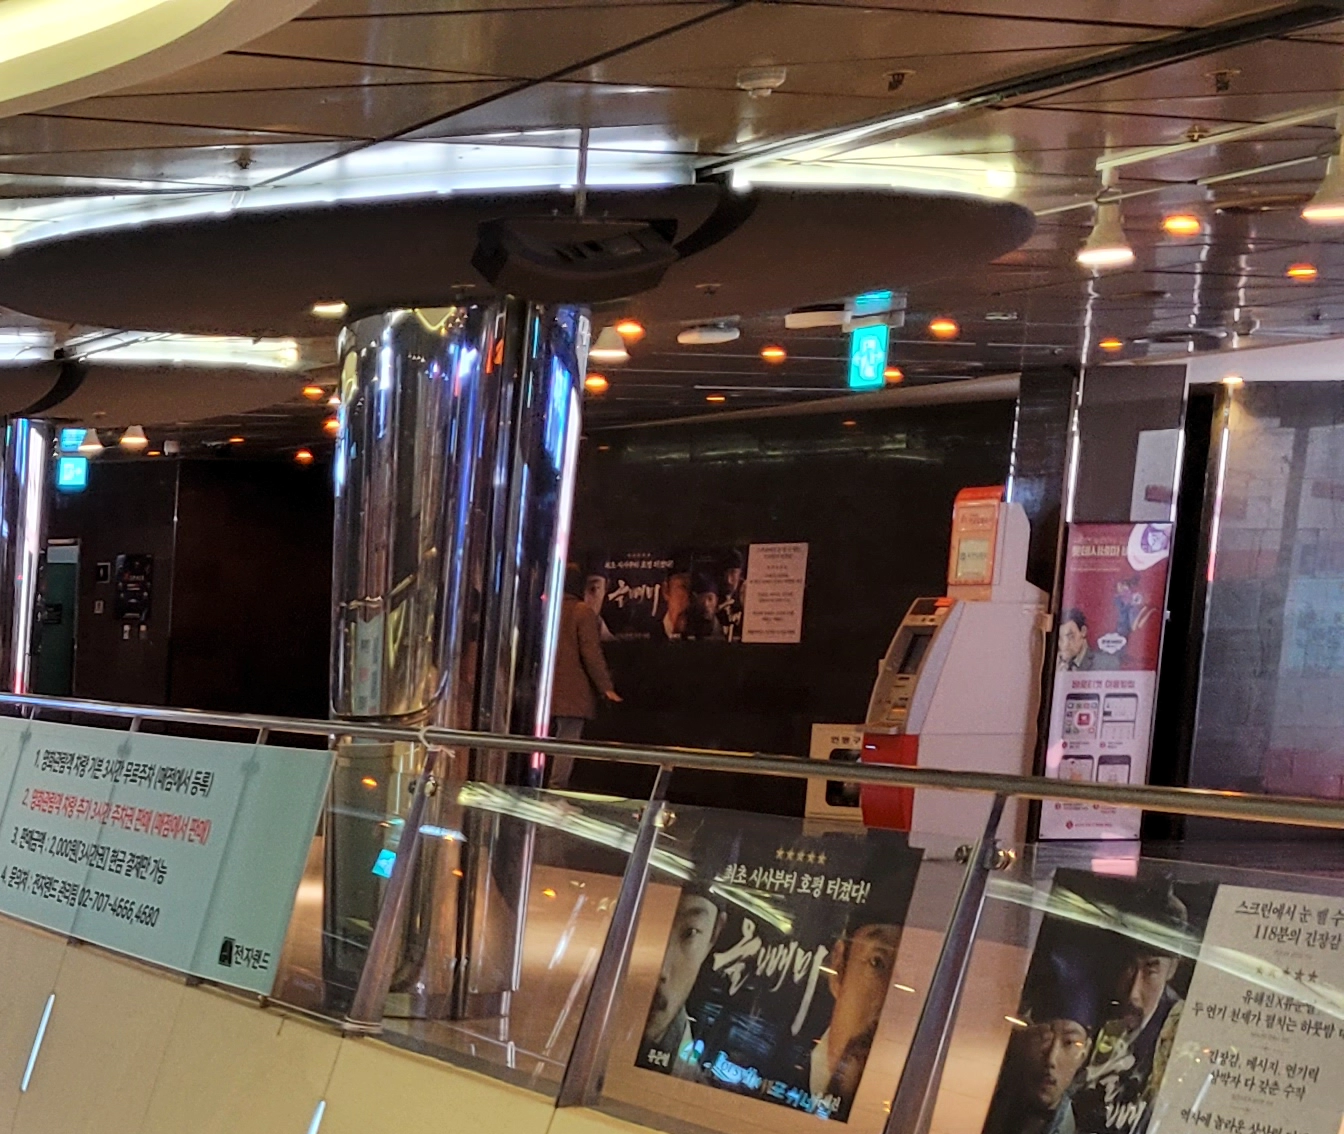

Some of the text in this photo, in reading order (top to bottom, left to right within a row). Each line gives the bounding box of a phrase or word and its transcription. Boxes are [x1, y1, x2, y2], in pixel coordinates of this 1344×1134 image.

[34, 749, 41, 768] 1.
[73, 755, 90, 778] 차량
[87, 757, 104, 780] 기본
[102, 759, 125, 783] 3시간
[123, 762, 157, 789] 무료주차
[190, 770, 215, 798] 등록)
[62, 796, 79, 819] 차량
[90, 801, 112, 825] 3시간
[11, 826, 19, 846] 3.
[19, 827, 47, 854] 판매금액
[108, 848, 127, 875] 현금
[124, 852, 152, 880] 결제만
[149, 857, 168, 885] 가능
[8, 866, 30, 892] 문의처
[31, 873, 60, 899] 전자랜드
[57, 880, 80, 907] 관리팀
[724, 863, 872, 904] 최초 시사부터 호평 터졌다!
[1235, 900, 1297, 922] 스크린에서
[1299, 907, 1313, 924] 눈
[1331, 911, 1344, 928] 수
[1254, 923, 1342, 951] 118분의 긴장감
[234, 944, 271, 971] 전자랜드
[712, 917, 829, 1036] 올빼미
[1192, 1001, 1205, 1017] 두
[1206, 1004, 1227, 1020] 연기
[1230, 1008, 1262, 1027] 천재가
[1264, 1013, 1298, 1033] 펼치는
[1211, 1070, 1243, 1090] 삼박자
[1244, 1076, 1256, 1091] 다
[1283, 1083, 1307, 1102] 수작
[1285, 1062, 1321, 1083] 연기력
[1180, 1108, 1213, 1129] 역사에
[1214, 1114, 1247, 1134] 놀라운
